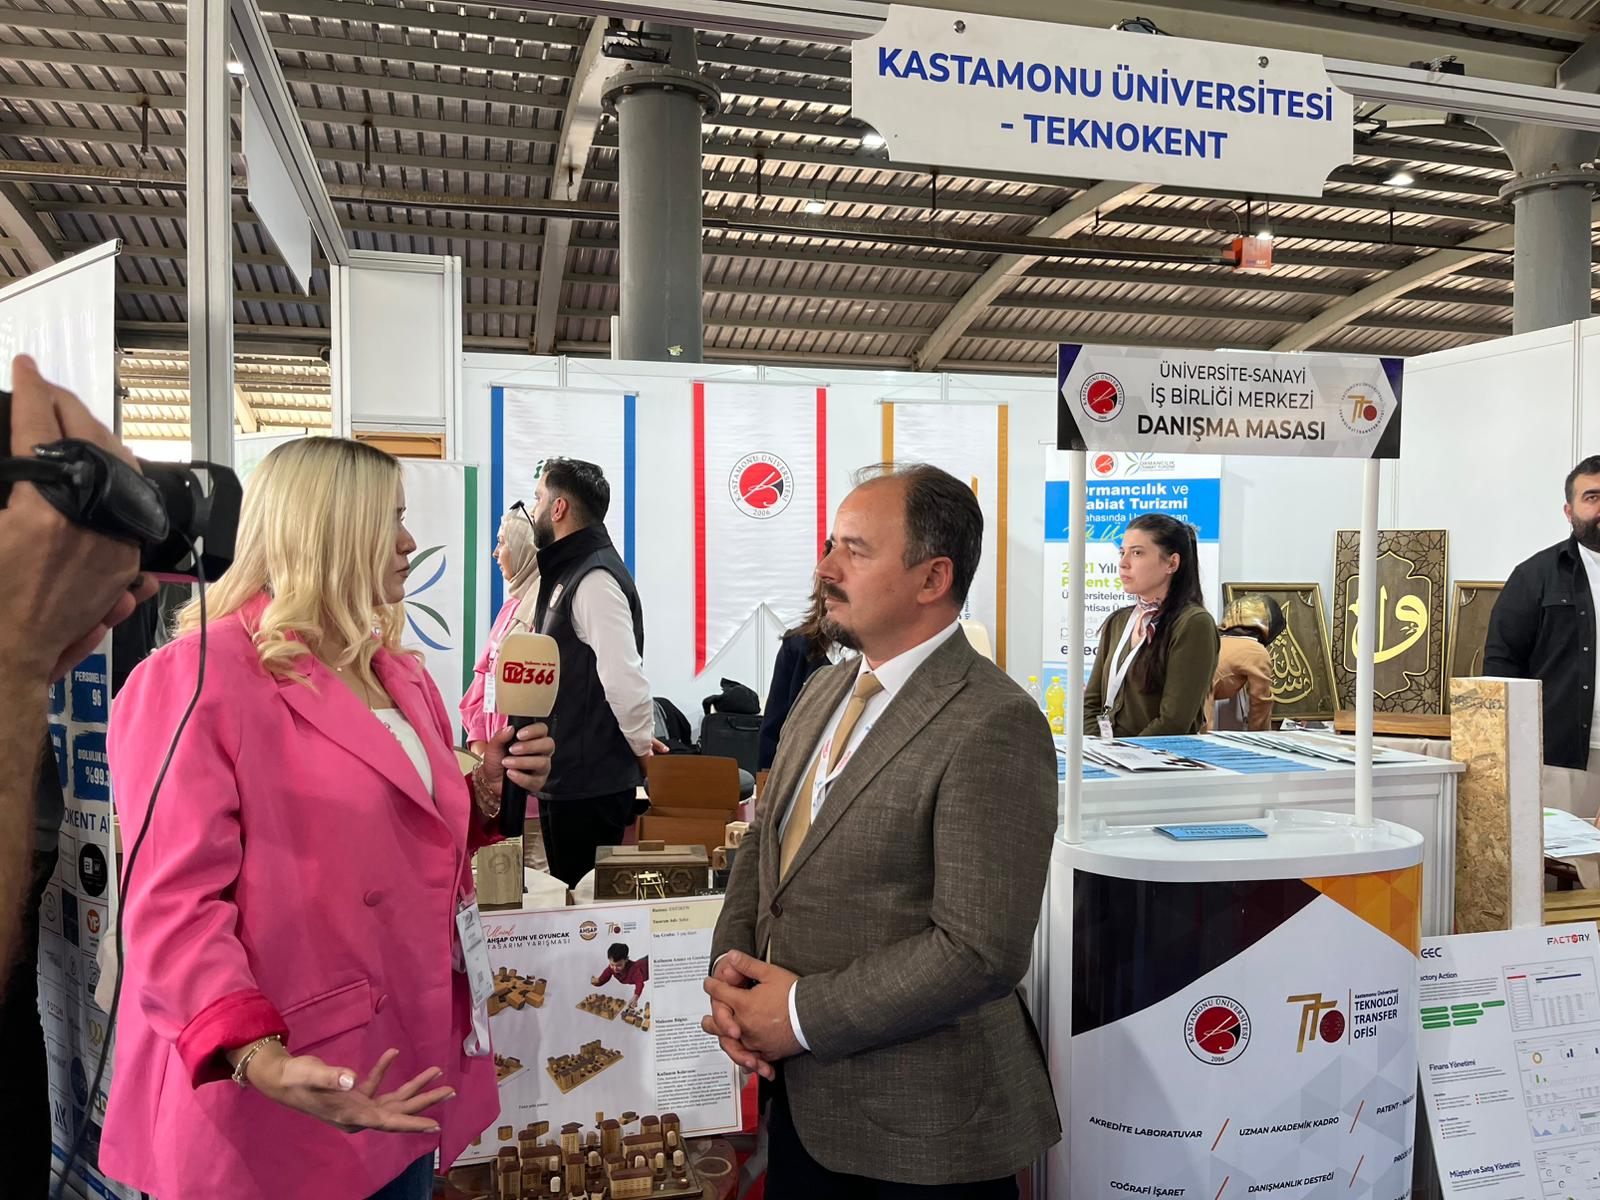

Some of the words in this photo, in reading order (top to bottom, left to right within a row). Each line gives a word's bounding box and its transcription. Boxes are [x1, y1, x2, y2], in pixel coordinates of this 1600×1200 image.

[878, 46, 1101, 98] KASTAMONU
[1112, 64, 1333, 121] ÜNİVERSİTESİ
[1023, 113, 1228, 160] TEKNOKENT
[1159, 361, 1306, 385] ÜNİVERSİTE-SANAYİ
[1150, 383, 1166, 409] İŞ
[1170, 385, 1233, 407] BİRLİĞİ
[1237, 390, 1314, 410] MERKEZİ
[1137, 415, 1240, 442] DANIŞMA
[1245, 419, 1325, 441] MASASI
[1172, 485, 1189, 495] ve
[1085, 497, 1125, 510] abiat
[1129, 497, 1188, 510] Turizmi
[486, 941, 523, 950] TASARIM
[527, 938, 571, 948] YARIŞMASI
[487, 936, 509, 945] AHŞAP
[510, 935, 528, 943] OYUN
[529, 933, 537, 941] VE
[538, 931, 570, 940] OYUNCAK
[1547, 933, 1591, 946] FACTORY
[1438, 971, 1458, 980] Action
[1354, 993, 1399, 1011] TEKNOLOJİ
[1187, 999, 1214, 1044] KASTAMONU
[1215, 998, 1249, 1040] ÜNİVERSİTESİ
[1353, 1008, 1398, 1025] TRANSFER
[1353, 1024, 1377, 1039] OFİSİ
[1429, 1062, 1449, 1071] Finans
[1449, 1059, 1476, 1069] Yönetimi
[1088, 1116, 1133, 1134] AKREDİTE
[1134, 1127, 1203, 1138] LABORATUVAR
[1239, 1126, 1270, 1136] UZMAN
[1270, 1119, 1313, 1134] AKADEMİK
[1312, 1116, 1340, 1127] KADRO
[1376, 1101, 1400, 1115] PATENT
[1493, 1160, 1521, 1172] Yönetimi
[1110, 1180, 1151, 1195] COĞRAFİ
[1152, 1186, 1186, 1197] İŞARET
[1248, 1179, 1303, 1194] DANIŞMANLIK
[1303, 1171, 1335, 1186] DESTEĞİ
